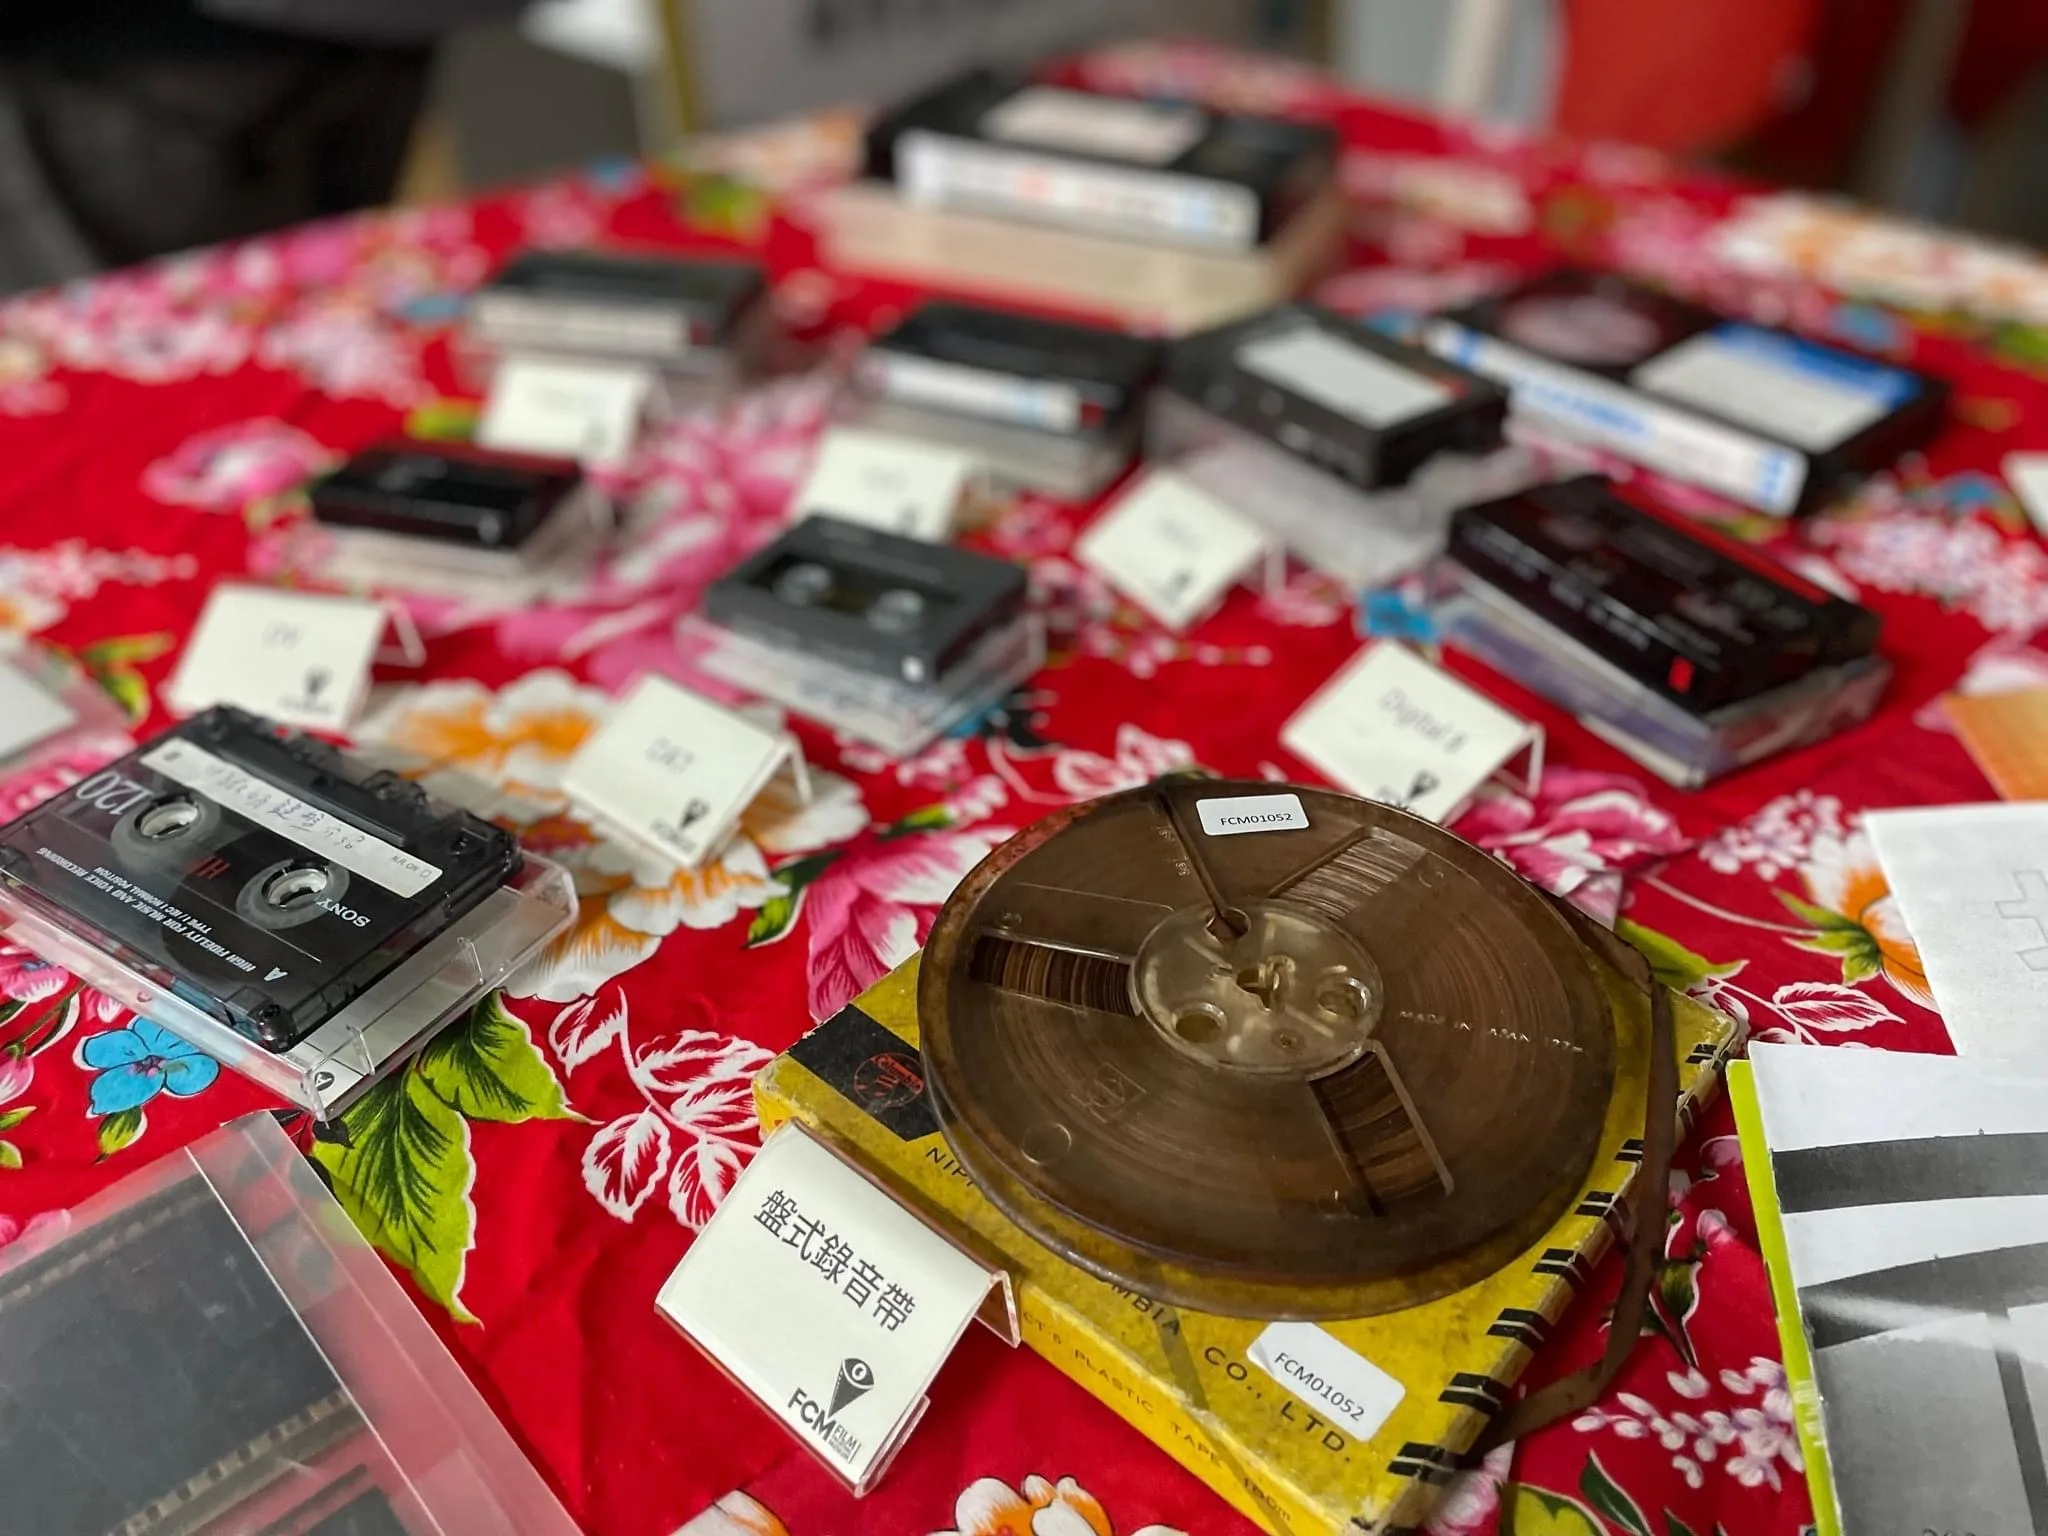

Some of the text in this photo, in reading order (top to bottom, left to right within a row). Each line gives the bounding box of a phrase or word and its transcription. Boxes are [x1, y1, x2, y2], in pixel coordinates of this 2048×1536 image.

[76, 771, 154, 815] 120
[1219, 812, 1294, 827] FCM01052
[93, 866, 133, 890] POSITION
[36, 846, 257, 973] HIGH FIDELITY FOR MUSIC AND VOICE RECORDING
[186, 918, 212, 935] TYPE
[316, 897, 371, 927] SONY
[264, 966, 289, 982] A
[753, 1188, 916, 1332] 盤式錄音帶
[1074, 1349, 1154, 1414] PLASTIC
[1170, 1420, 1223, 1468] TAPE
[1204, 1346, 1263, 1400] CO.,
[1280, 1401, 1351, 1463] LTD.
[1273, 1352, 1366, 1422] FCM01052
[787, 1387, 837, 1441] FCM
[834, 1424, 858, 1449] FILM
